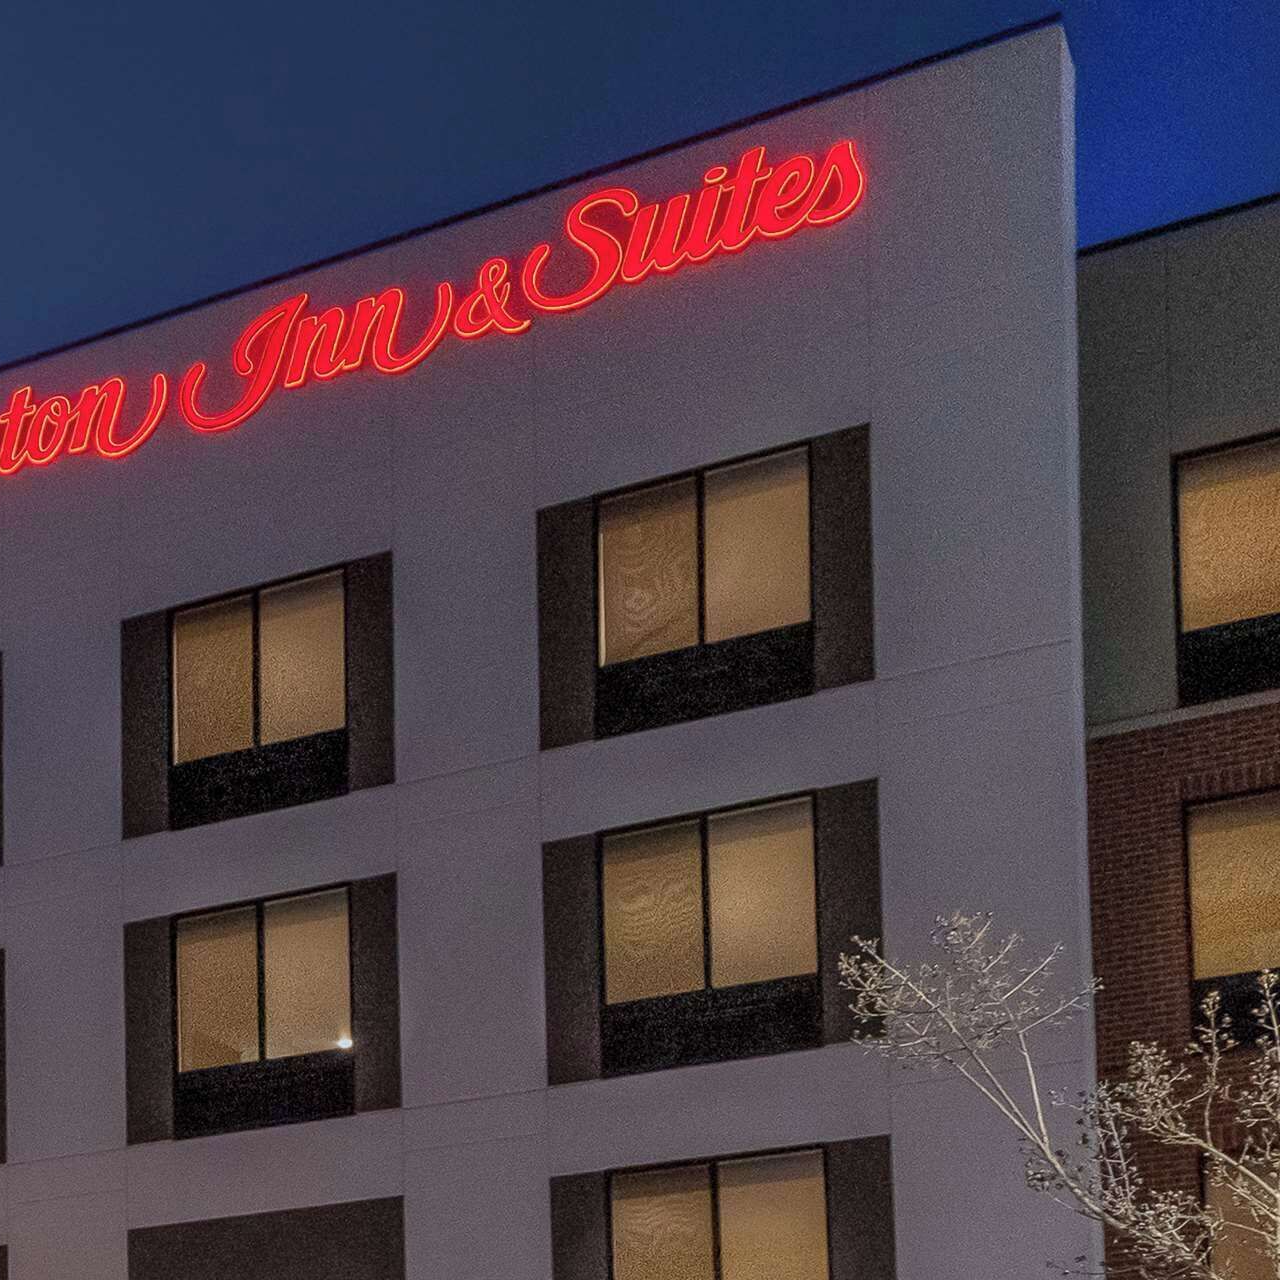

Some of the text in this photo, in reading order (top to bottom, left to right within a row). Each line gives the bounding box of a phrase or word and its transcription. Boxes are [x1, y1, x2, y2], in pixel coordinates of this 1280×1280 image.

[178, 280, 453, 434] Inn
[452, 256, 532, 340] &
[520, 138, 868, 312] Suites
